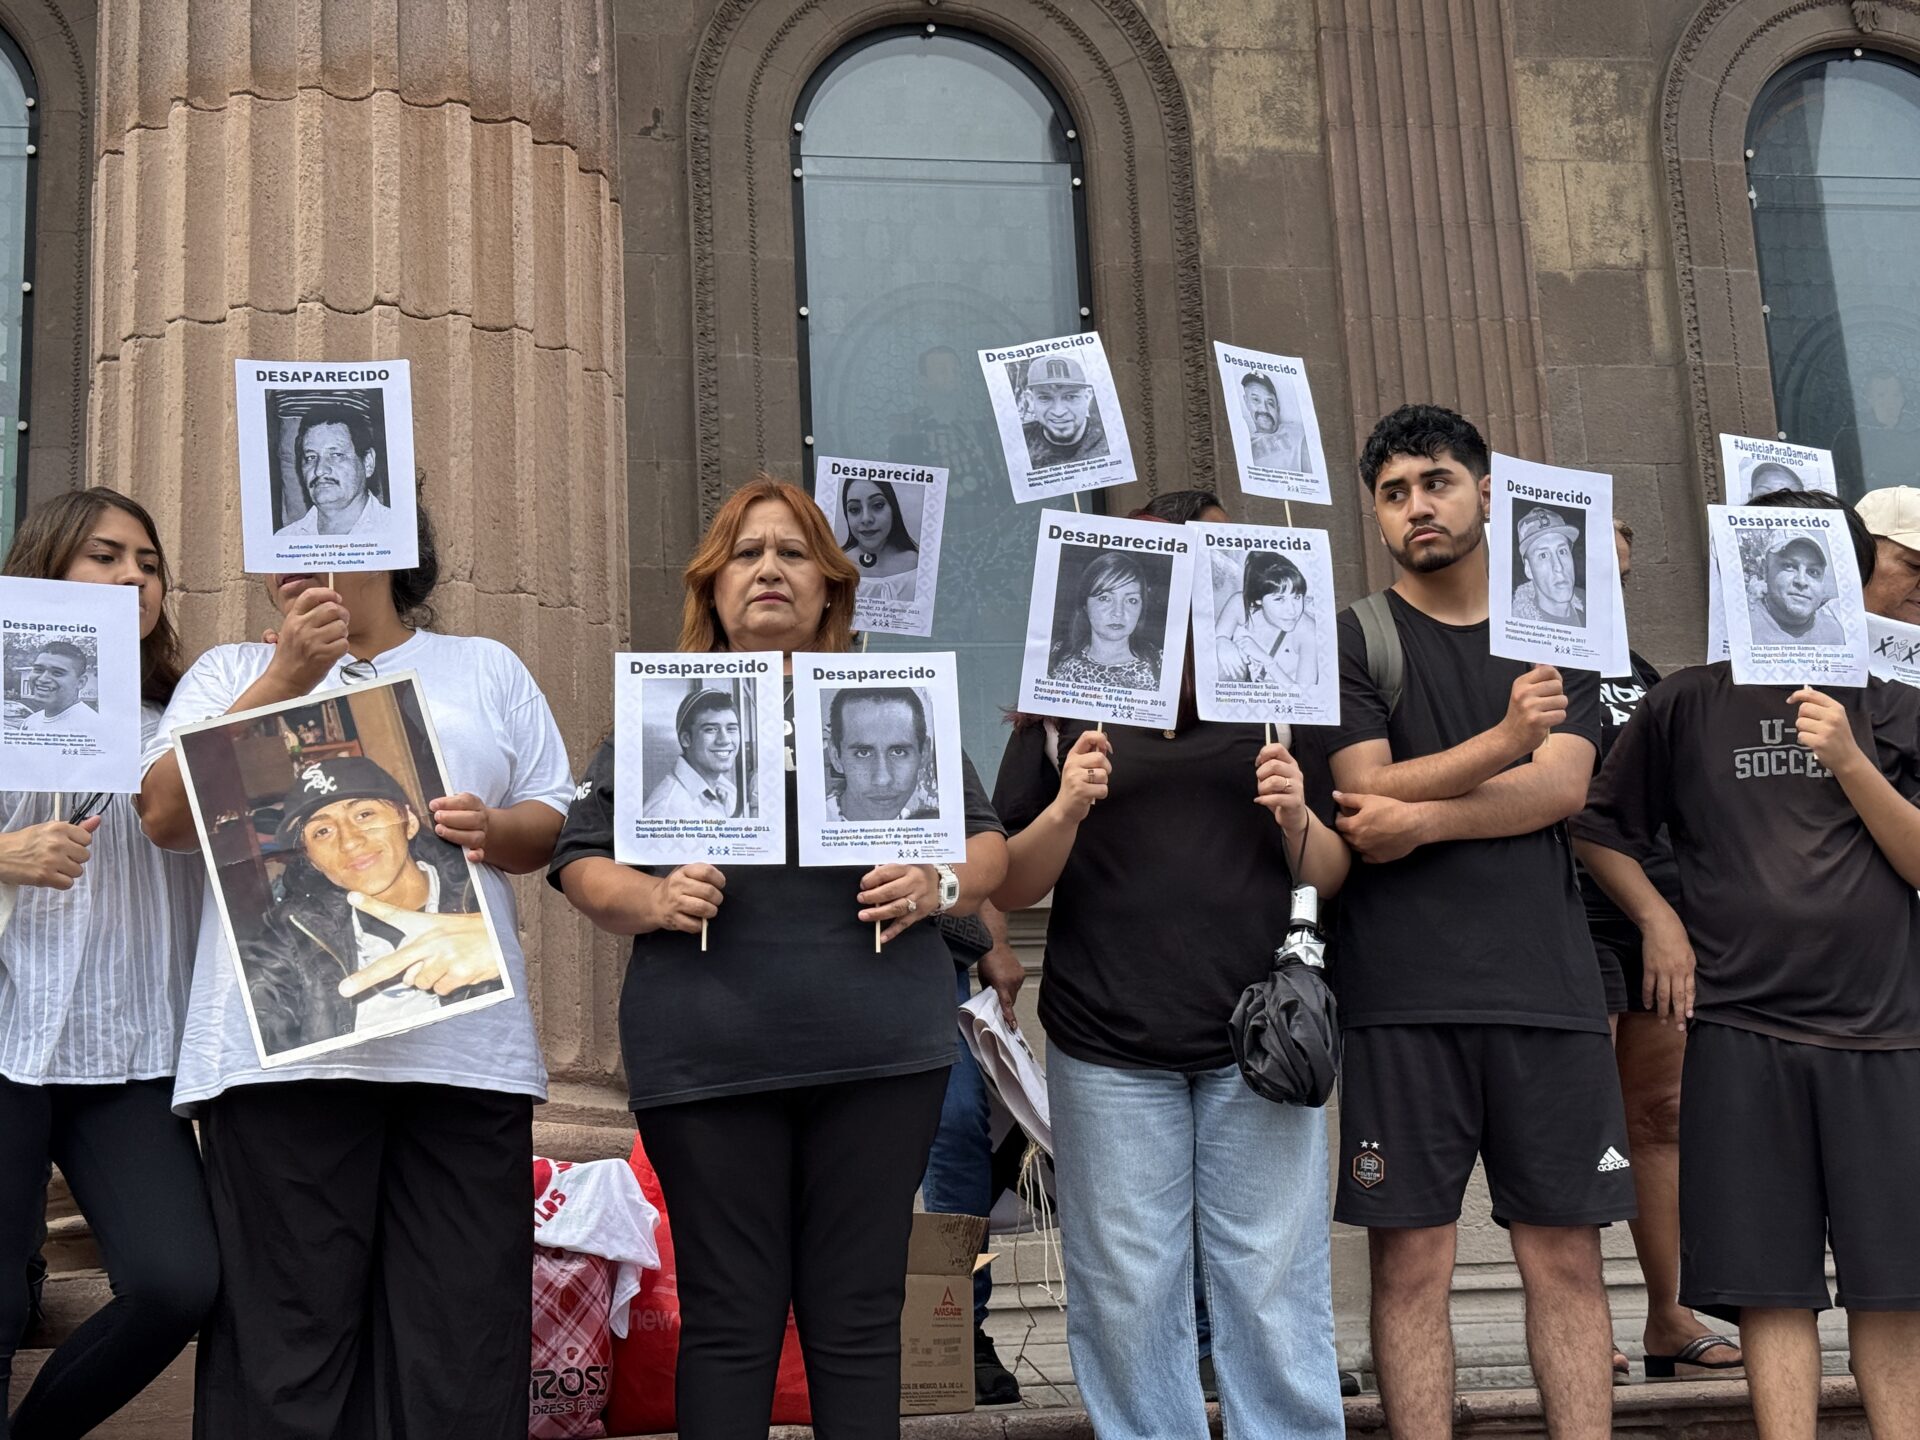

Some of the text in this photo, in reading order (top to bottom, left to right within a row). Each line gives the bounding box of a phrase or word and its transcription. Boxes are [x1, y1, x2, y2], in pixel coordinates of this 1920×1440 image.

[986, 336, 1094, 362] Desaparecido
[1224, 354, 1297, 375] Desaparecido
[256, 370, 390, 382] DESAPARECIDO
[1752, 452, 1804, 466] FEMINICIDIO
[832, 462, 934, 483] Desaparecida
[1507, 480, 1592, 505] Desaparecido
[1728, 516, 1830, 530] Desaparecido
[1048, 524, 1188, 554] Desaparecida
[1205, 534, 1311, 550] Desaparecida
[3, 620, 97, 633] Desaparecido
[631, 660, 768, 677] Desaparecido
[813, 666, 936, 682] Desaparecido
[1034, 686, 1080, 696] Desaparecida
[1102, 686, 1132, 695] Carranza
[1072, 698, 1094, 707] Flores,
[1597, 1158, 1630, 1172] adidas
[535, 1188, 566, 1222] LOS
[630, 1308, 680, 1330] new
[532, 1366, 608, 1400] ROSS
[532, 1401, 574, 1415] DRESS
